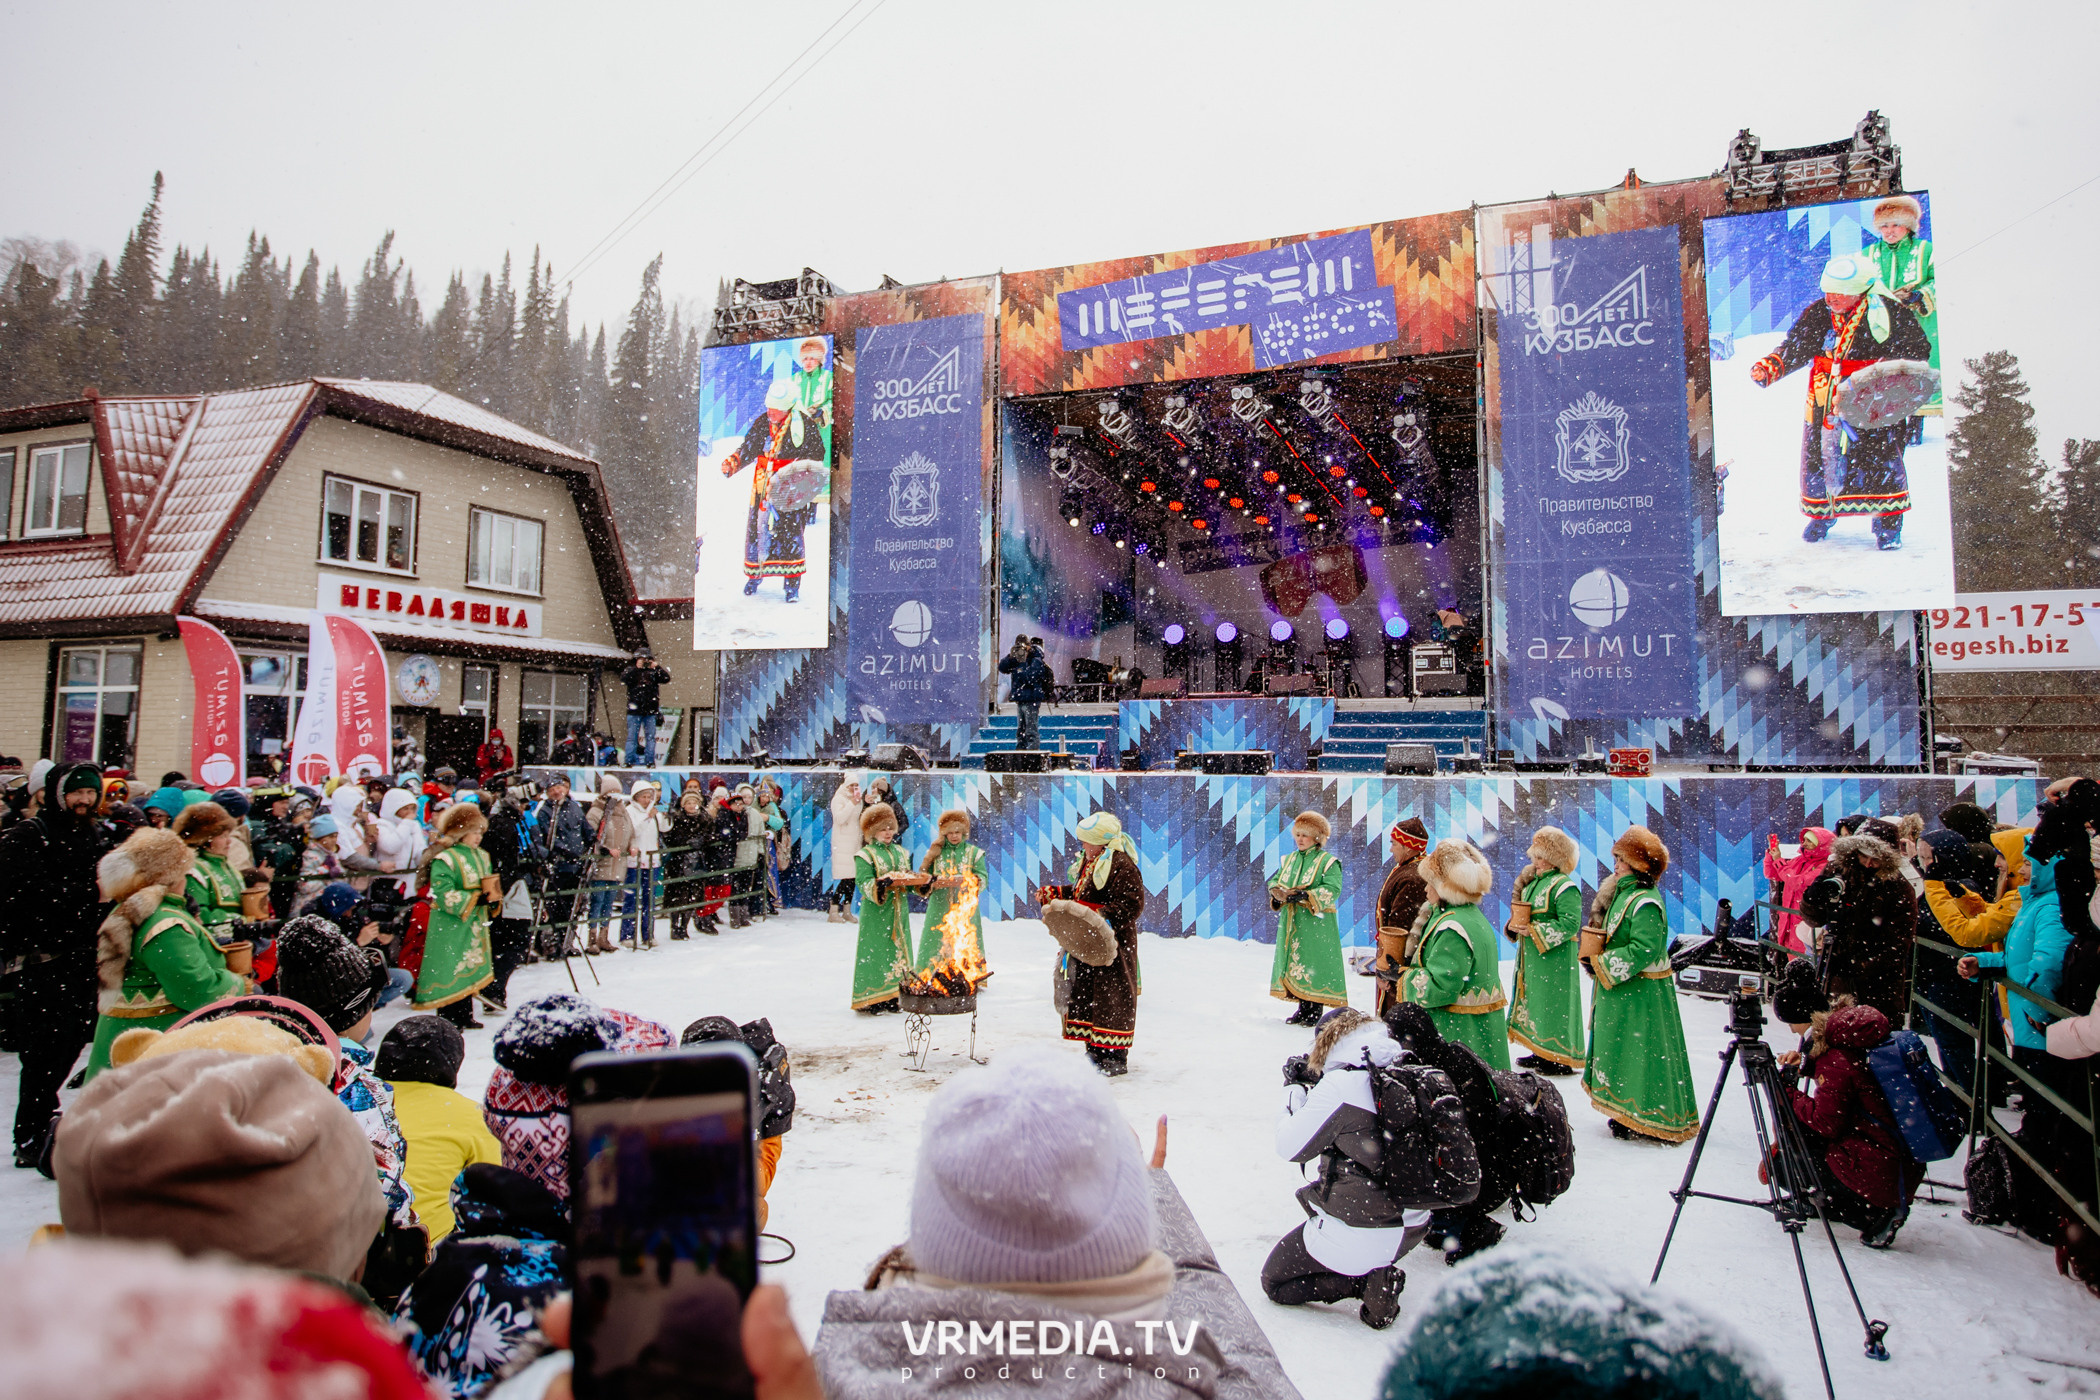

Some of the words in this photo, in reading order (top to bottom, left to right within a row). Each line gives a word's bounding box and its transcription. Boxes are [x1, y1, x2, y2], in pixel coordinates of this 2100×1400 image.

[1079, 256, 1353, 337] ШЕРЕГЕШ
[1524, 303, 1580, 331] 300
[1524, 320, 1655, 357] КУЗБАСС
[873, 377, 913, 401] 300
[872, 393, 962, 421] КУЗБАСС
[1538, 495, 1653, 515] Правительство
[1561, 519, 1632, 538] Кузбасса
[874, 537, 954, 555] Правительство
[889, 557, 937, 573] Кузбасса
[340, 584, 529, 629] НЕВАЛЯШКА
[1931, 603, 2100, 630] 921-17-5
[1929, 634, 2070, 661] egesh.biz
[890, 679, 932, 691] HOTELS
[1571, 666, 1633, 679] HOTELS
